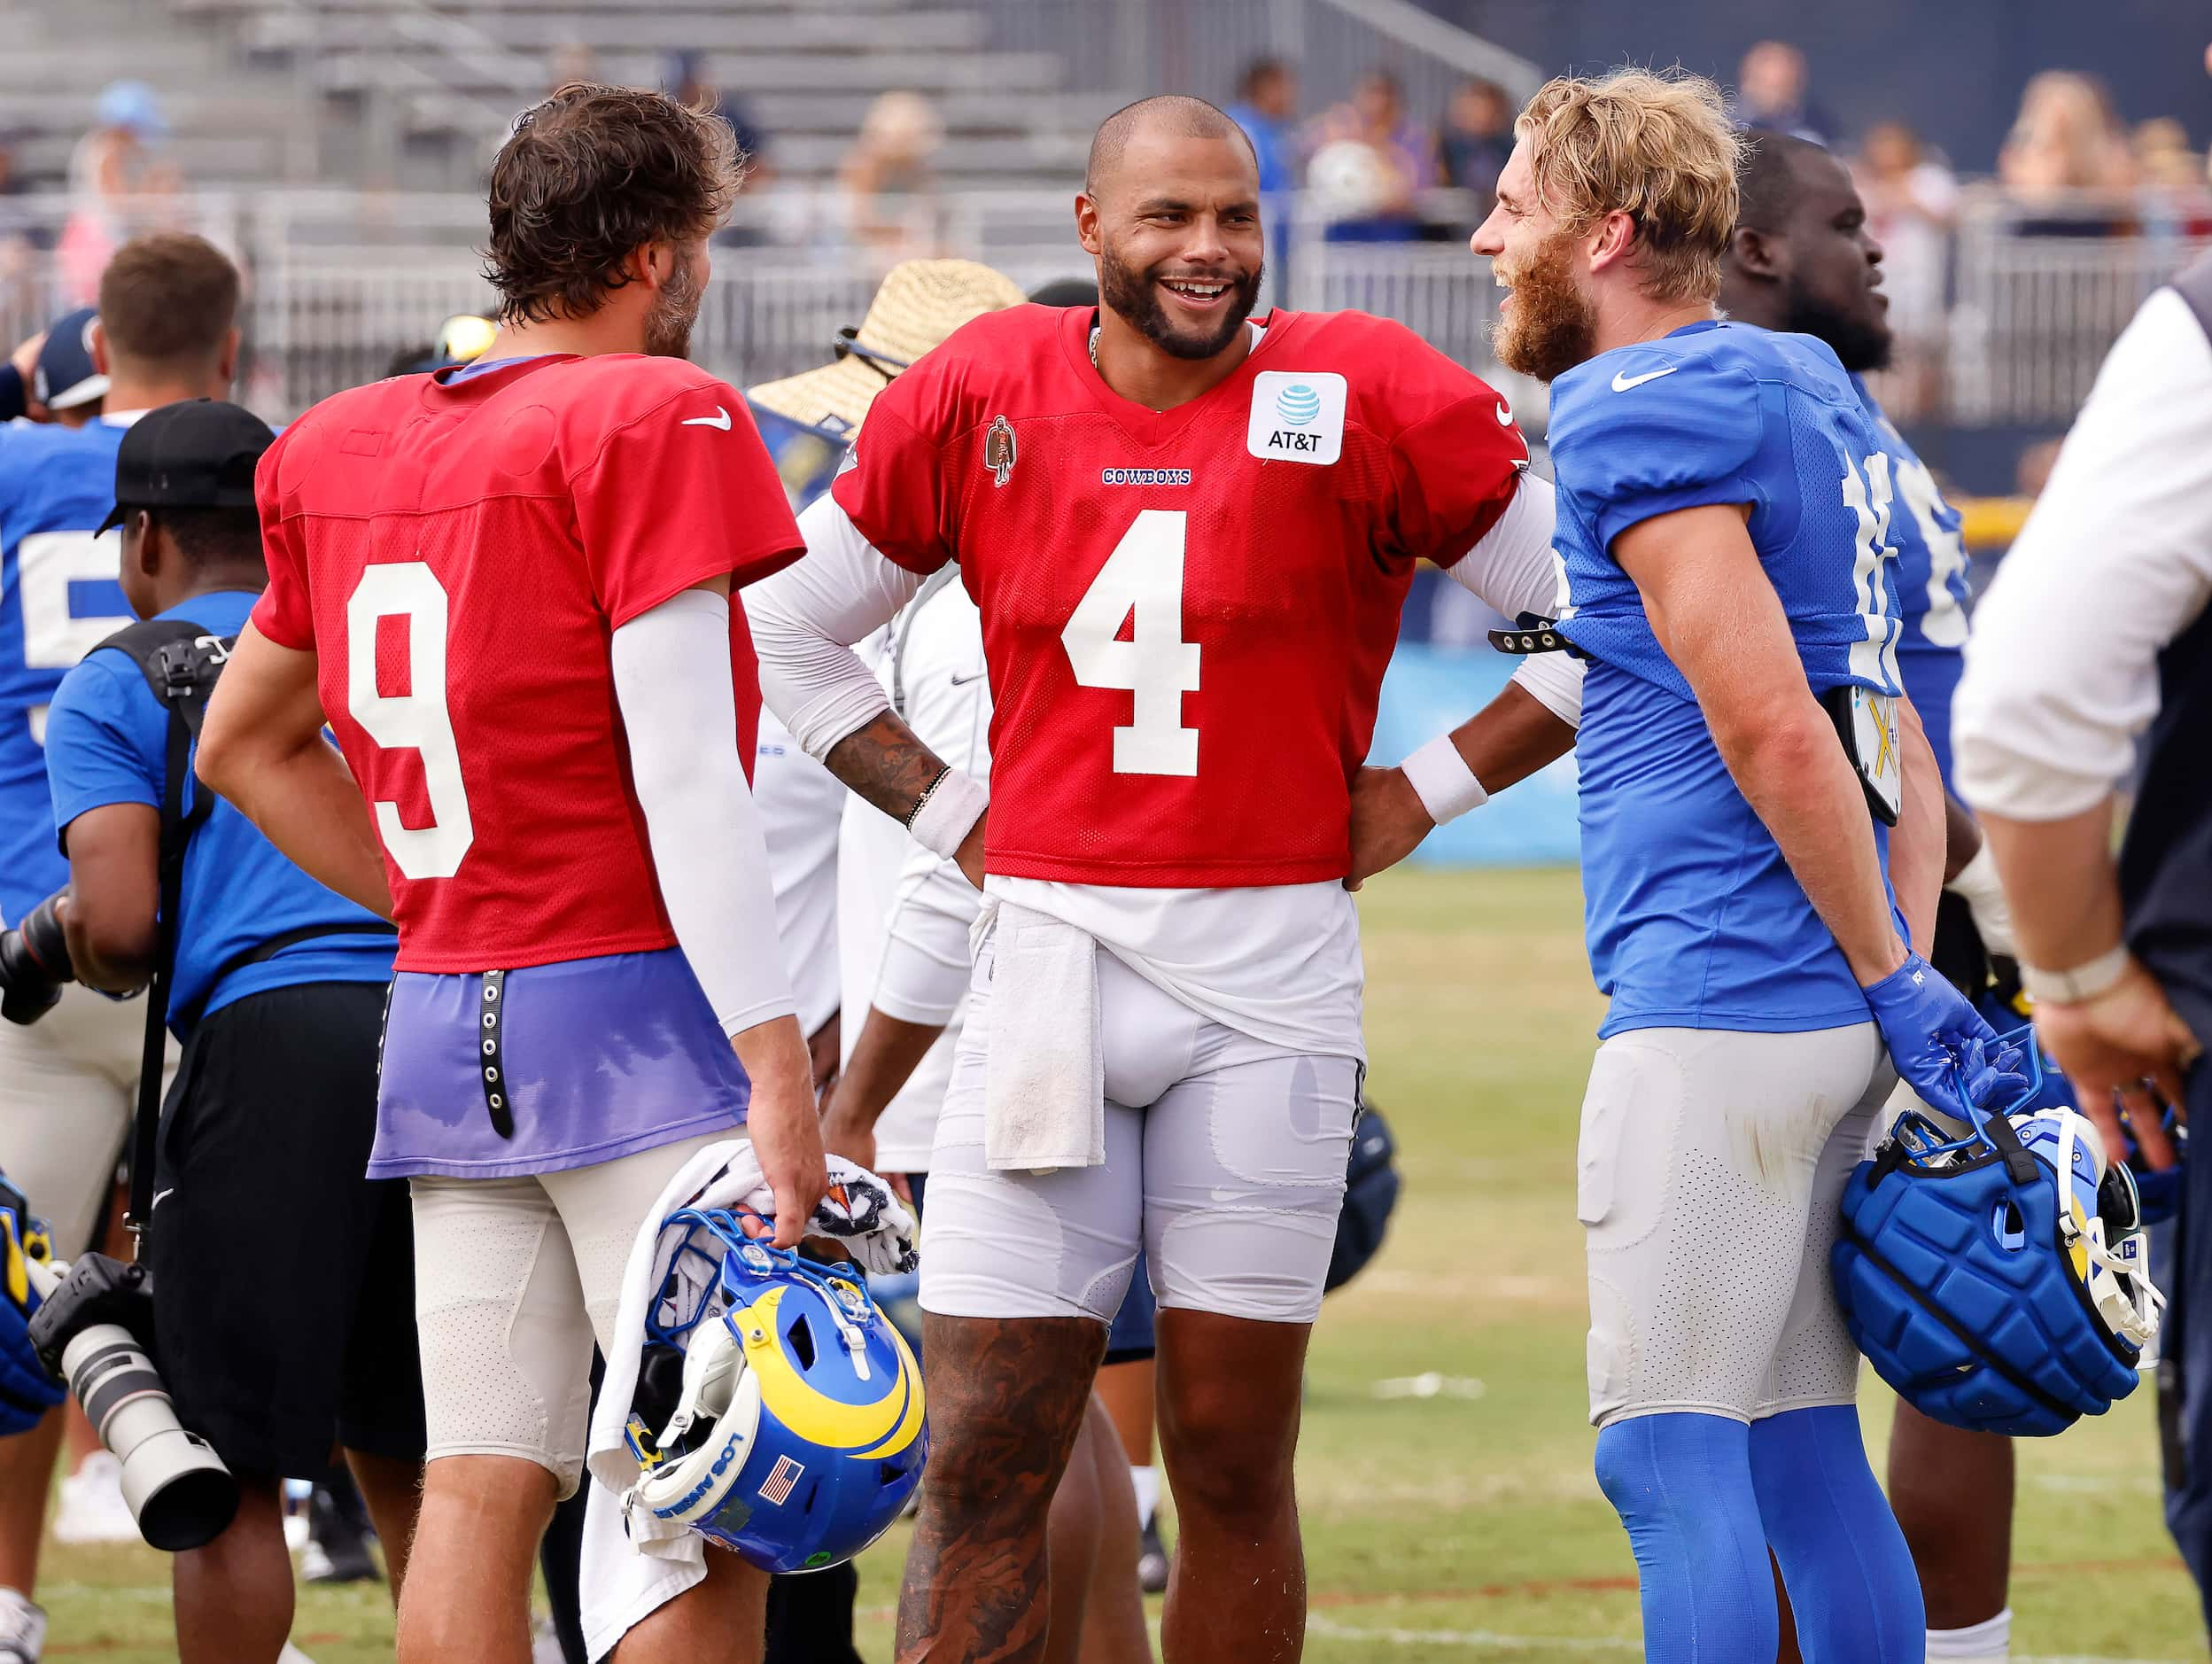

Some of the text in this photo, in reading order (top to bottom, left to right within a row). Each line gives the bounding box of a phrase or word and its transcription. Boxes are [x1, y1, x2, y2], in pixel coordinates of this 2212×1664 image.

[1268, 430, 1323, 453] AT&T
[1103, 468, 1191, 485] COWBOYS
[1059, 509, 1202, 777] 4
[346, 561, 475, 880] 9
[711, 1432, 744, 1477] LOS
